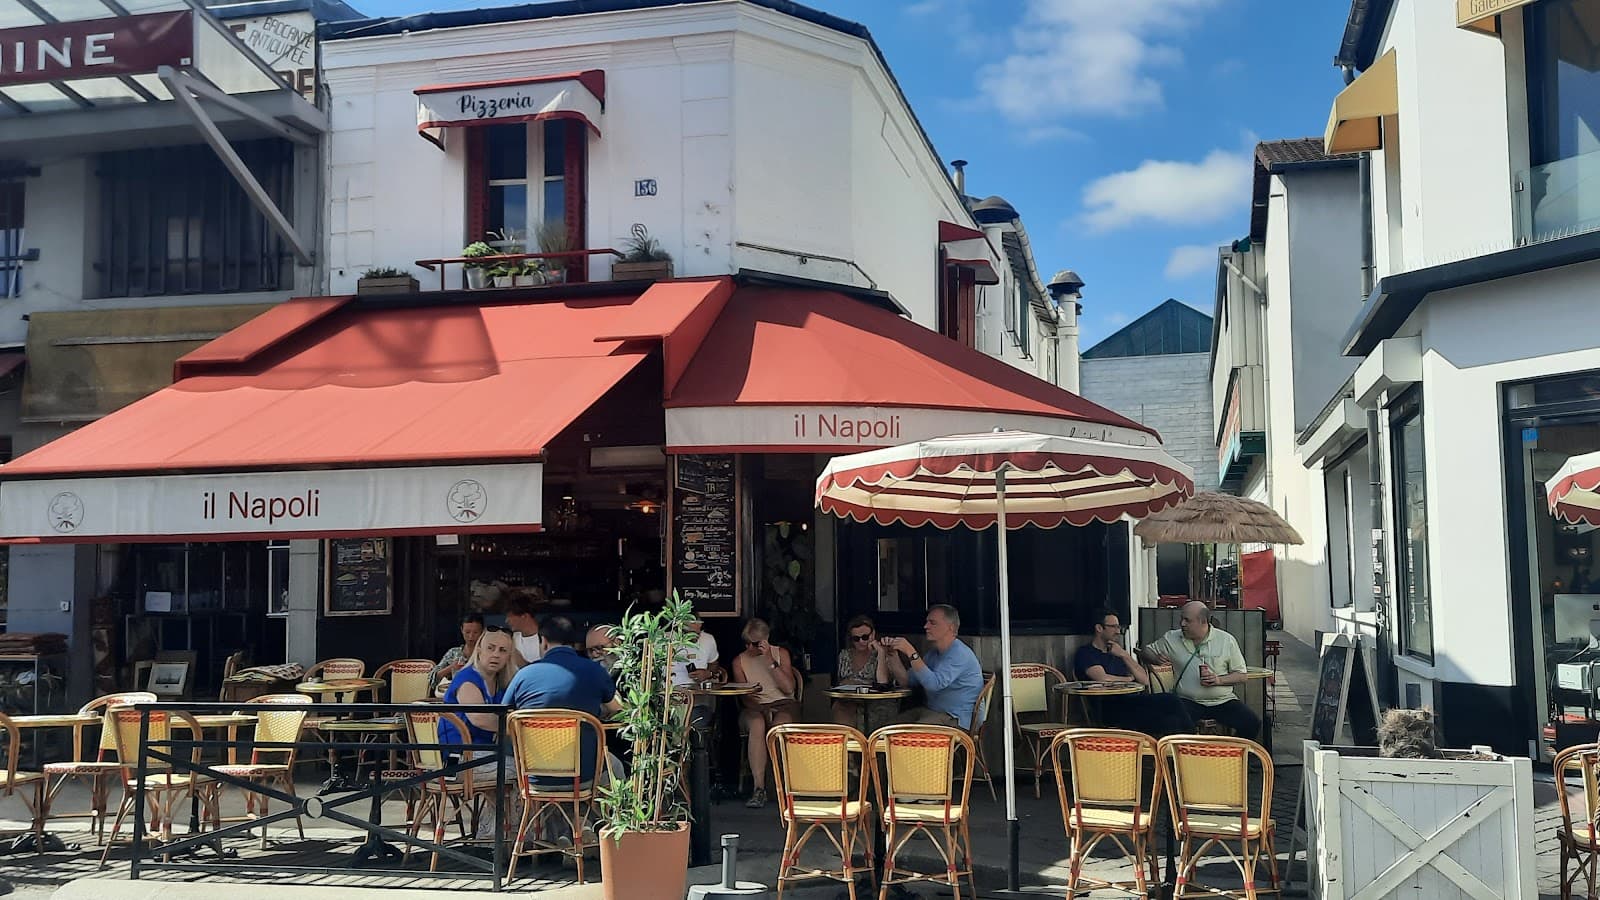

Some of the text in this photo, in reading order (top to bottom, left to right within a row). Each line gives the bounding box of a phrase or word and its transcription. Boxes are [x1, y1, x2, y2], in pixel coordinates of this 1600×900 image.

[0, 32, 115, 73] INE
[456, 92, 534, 118] Pizzeria
[794, 414, 900, 444] il Napoli
[203, 489, 320, 525] il Napoli
